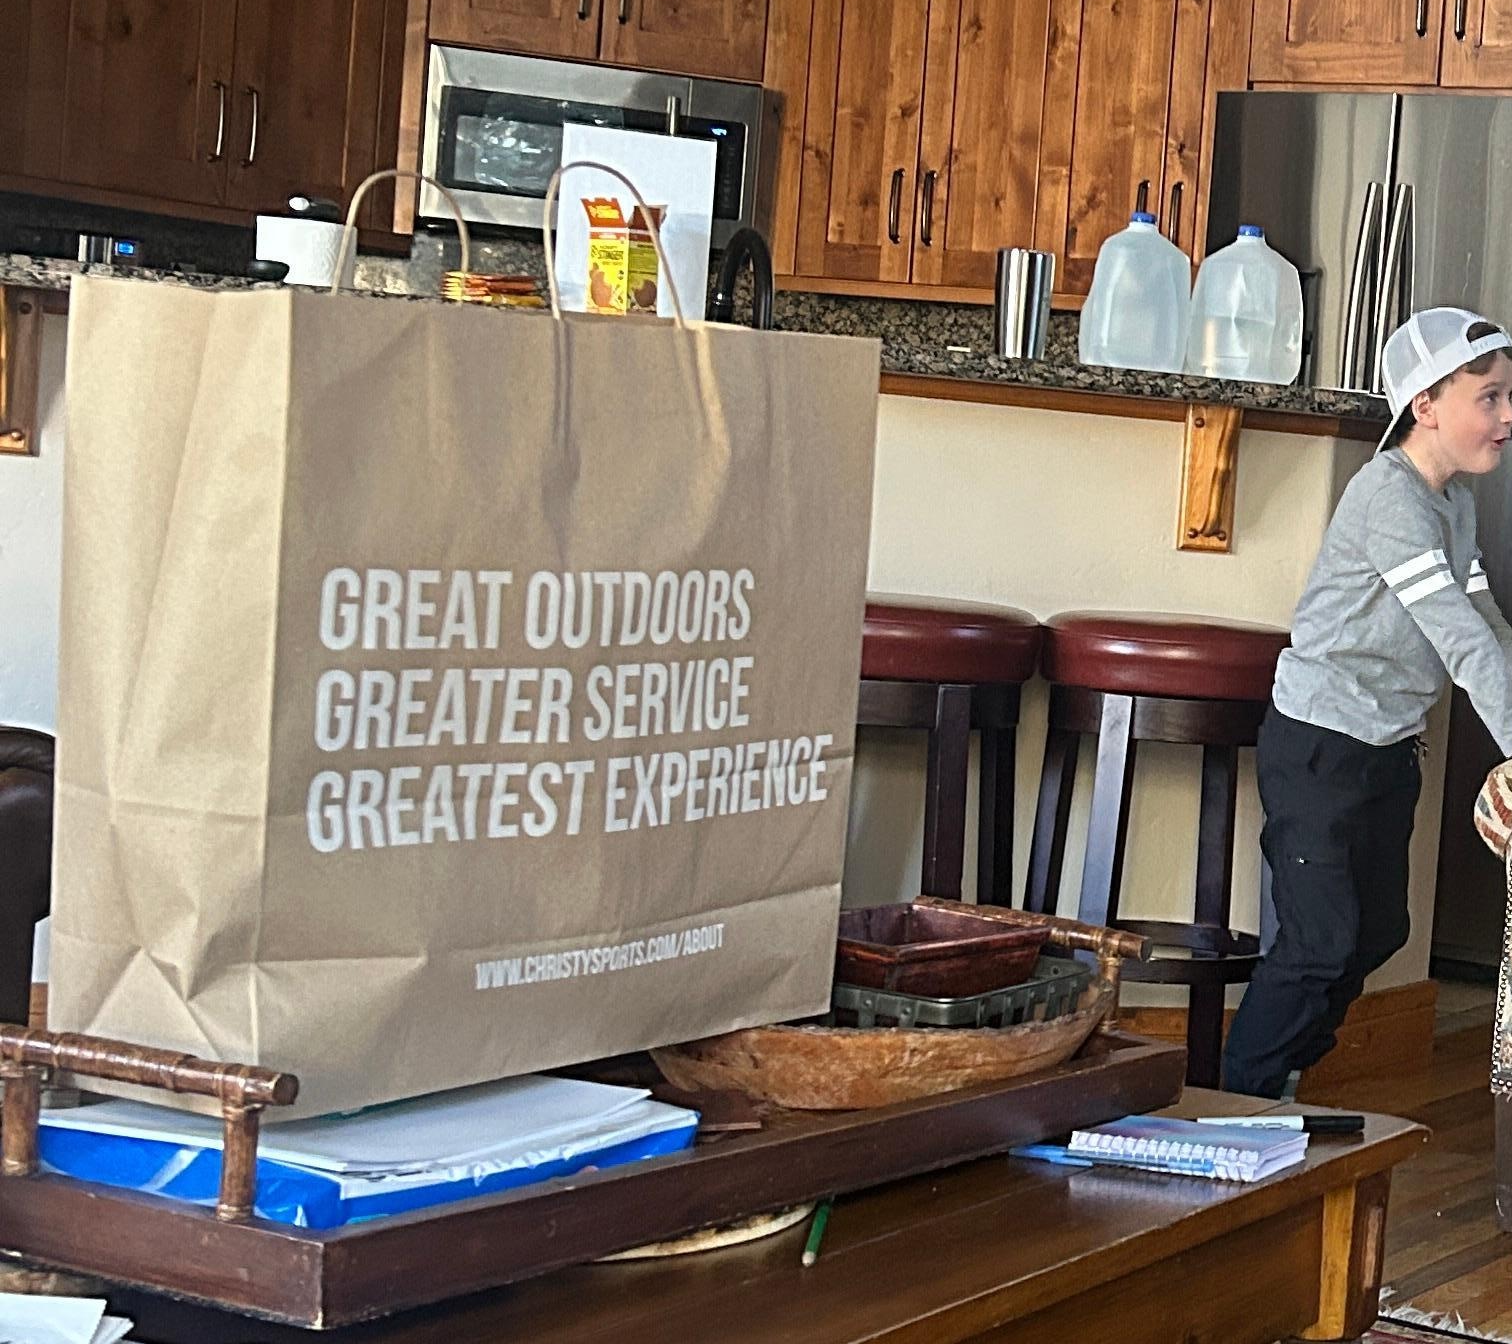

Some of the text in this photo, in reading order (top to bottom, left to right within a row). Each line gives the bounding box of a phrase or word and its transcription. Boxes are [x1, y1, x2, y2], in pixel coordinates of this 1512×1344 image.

[319, 567, 755, 651] GREAT OUTDOORS
[313, 656, 755, 752] GREATER SERVICE
[306, 734, 833, 853] GREATEST EXPERIENCE
[475, 923, 725, 990] WWW.CHRISTYSPORTS.COM/ABOUT
